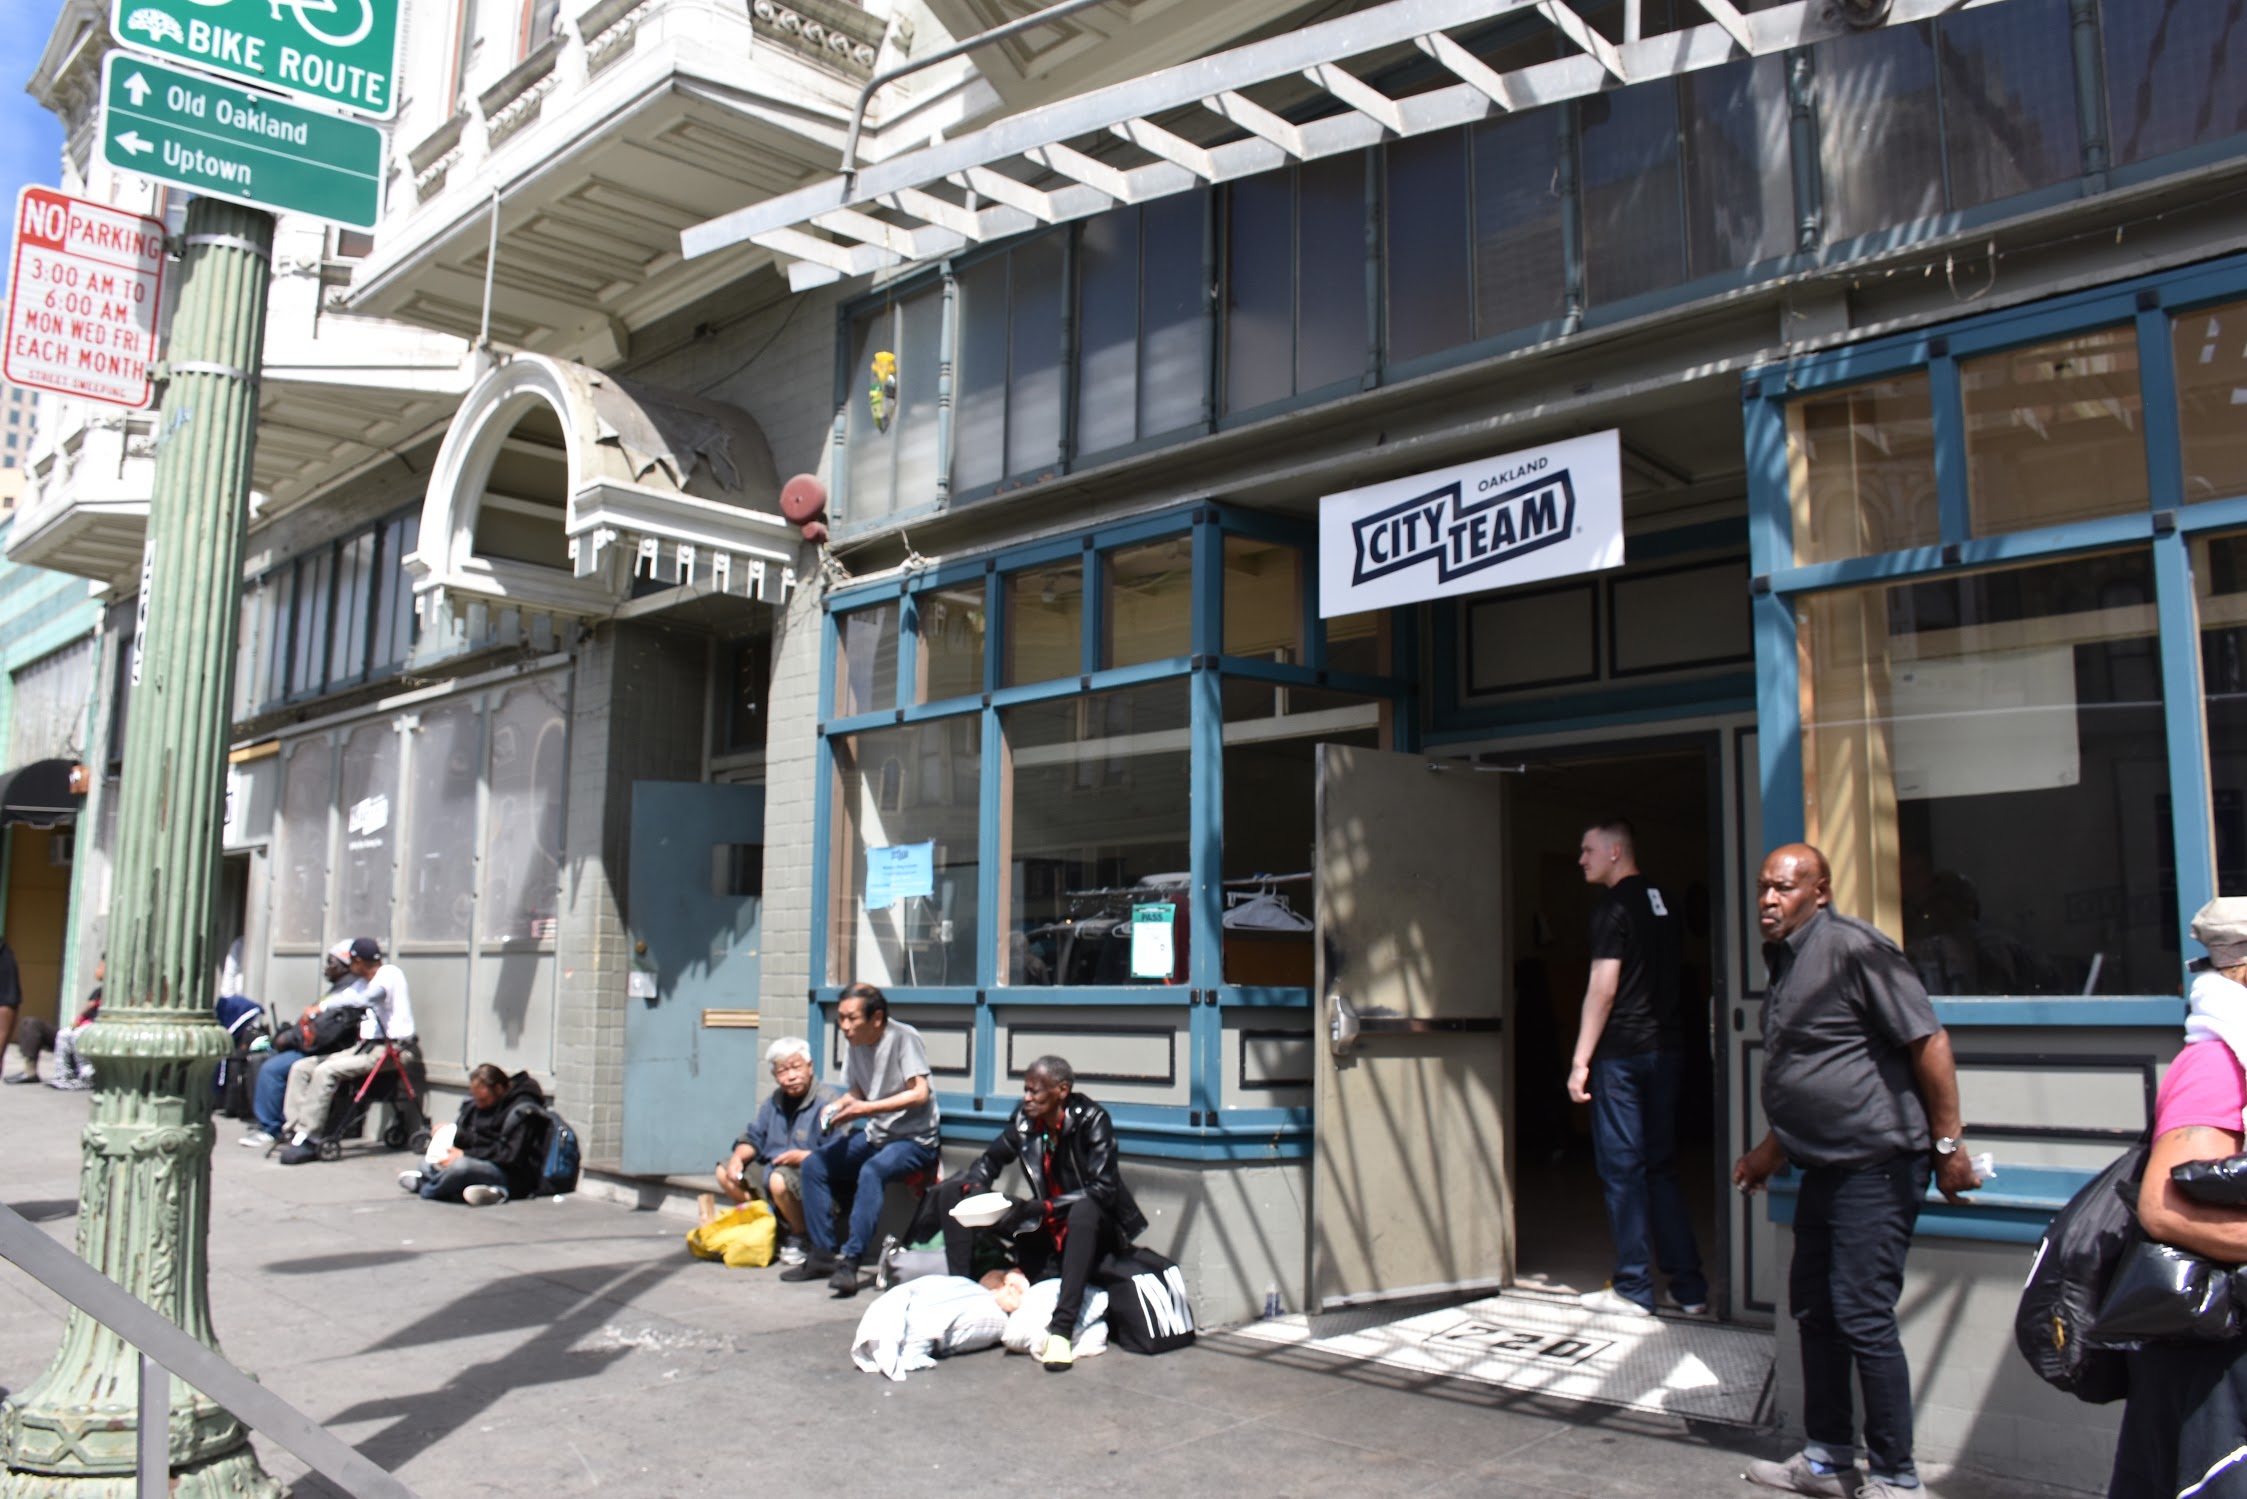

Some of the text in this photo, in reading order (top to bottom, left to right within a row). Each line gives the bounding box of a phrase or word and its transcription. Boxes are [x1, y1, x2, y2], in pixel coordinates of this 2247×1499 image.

[188, 18, 385, 106] BIKE ROUTE
[167, 85, 308, 146] Old Oakland
[163, 140, 251, 186] Uptown
[23, 197, 160, 260] NO PARKING
[32, 258, 145, 303] 3:00 AM TO
[45, 289, 127, 324] 6:00 AM
[26, 309, 139, 353] MON WED FRI
[16, 334, 145, 382] EACH MONTH
[28, 370, 127, 398] STREET SWEEPING
[1478, 456, 1549, 493] OAKLAND
[1370, 488, 1558, 566] CITY TEAM
[1446, 1325, 1591, 1358] 720
